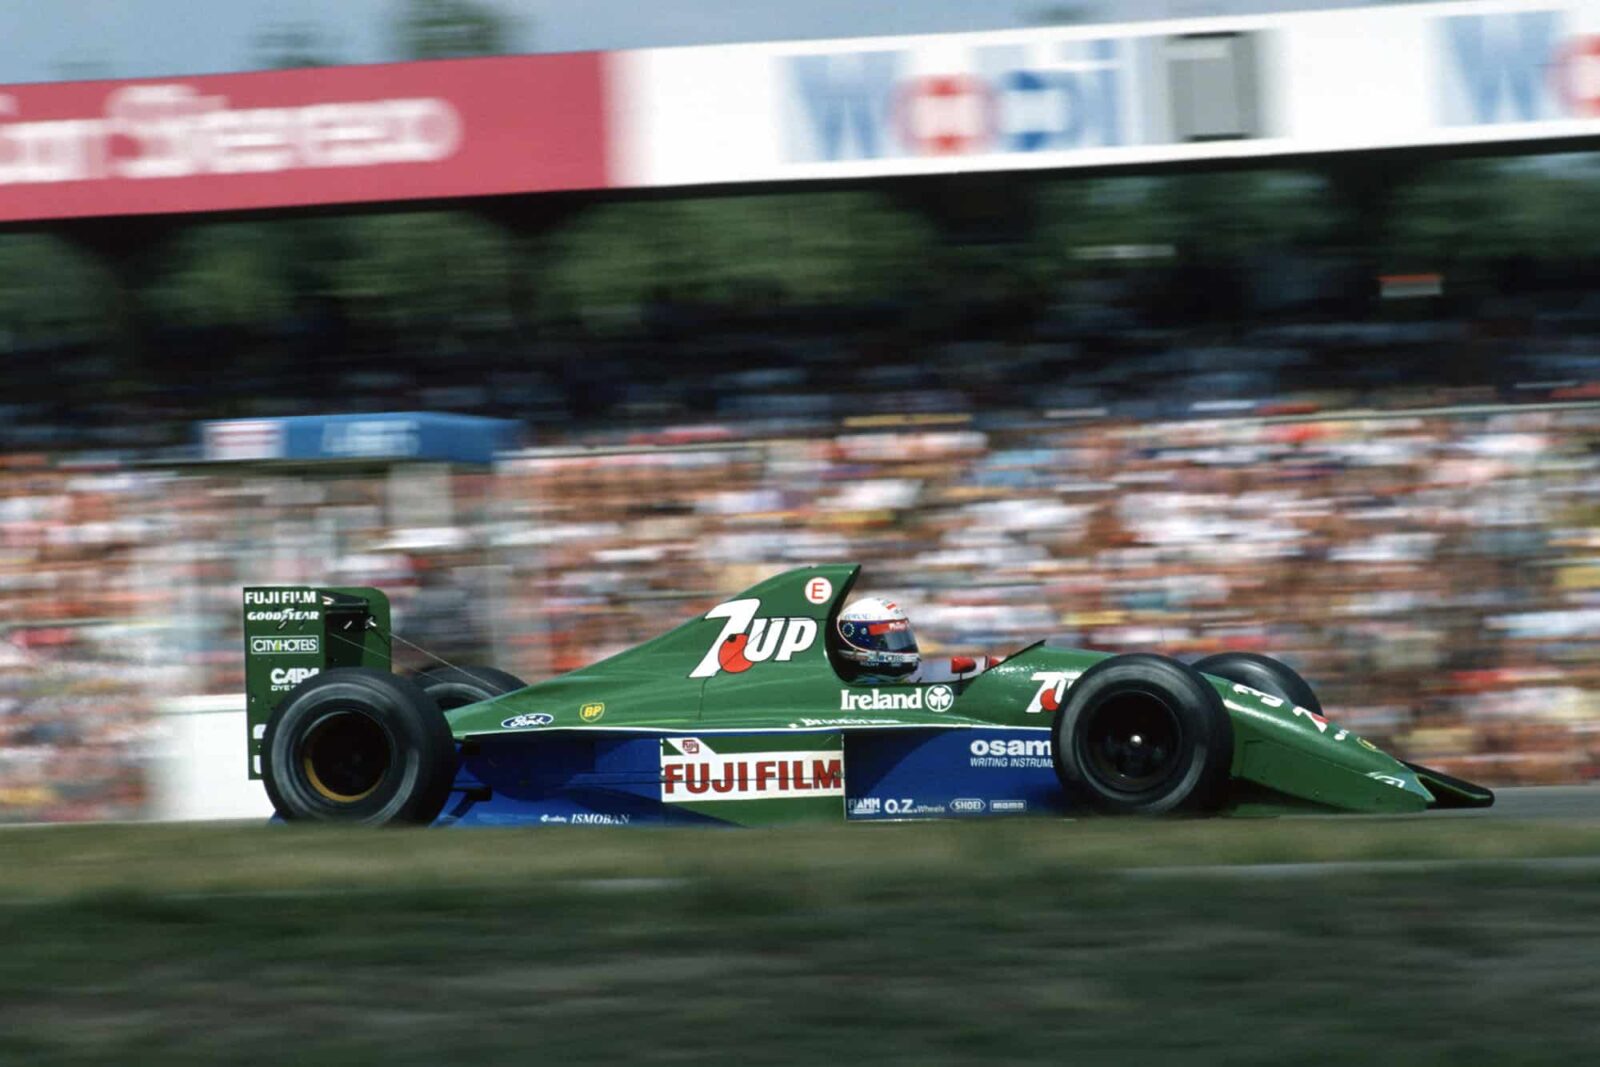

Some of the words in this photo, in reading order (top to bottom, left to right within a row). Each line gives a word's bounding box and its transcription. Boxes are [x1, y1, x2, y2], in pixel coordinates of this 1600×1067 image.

[245, 591, 279, 604] FUJI
[282, 591, 316, 603] FILM
[811, 582, 825, 600] E
[247, 609, 319, 622] GOODYEAR
[253, 639, 275, 652] CITY
[280, 639, 316, 652] HOTELS
[689, 598, 818, 678] 7UP
[840, 688, 922, 711] Ireland
[584, 706, 602, 718] BP
[970, 739, 1052, 756] osam
[970, 757, 1008, 768] WRITING
[664, 762, 748, 795] FUJI
[756, 759, 842, 791] FILM
